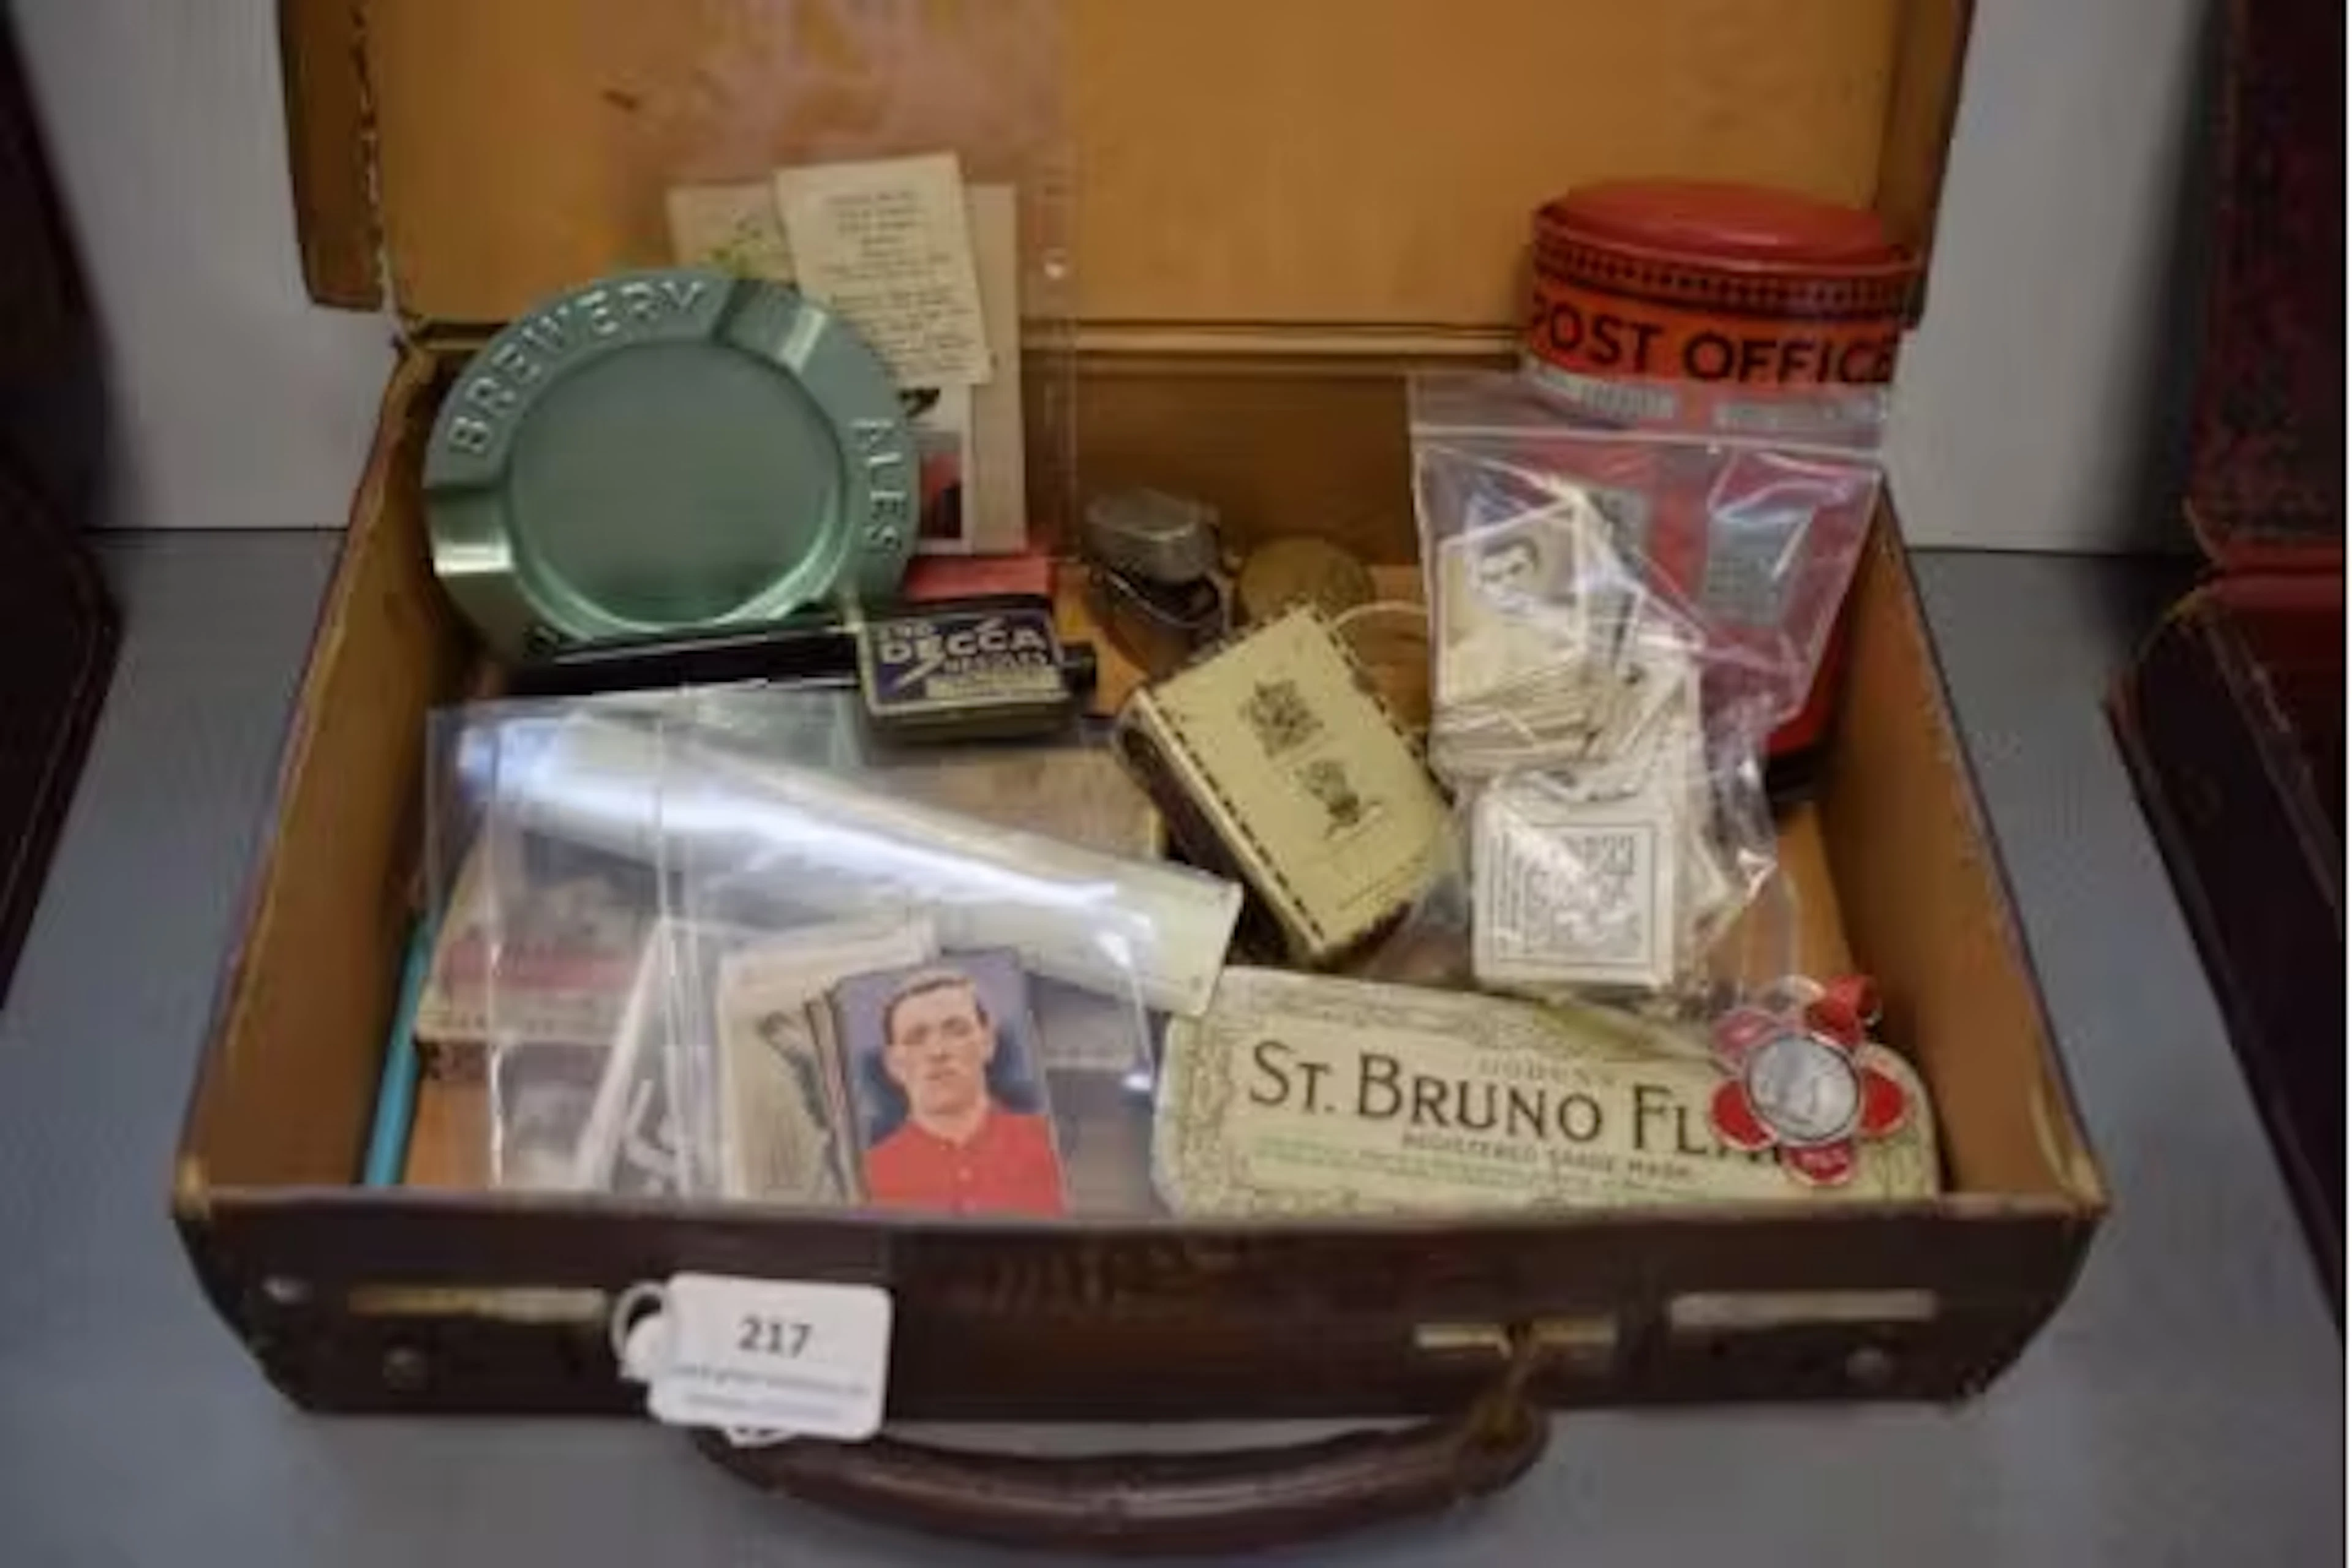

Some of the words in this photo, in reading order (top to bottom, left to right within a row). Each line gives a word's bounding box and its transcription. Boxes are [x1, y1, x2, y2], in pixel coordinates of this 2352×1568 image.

[448, 279, 706, 456] BREWERY
[853, 417, 905, 557] ALES
[880, 625, 1047, 665] DECCA
[1356, 1050, 1602, 1142] BRUNO
[737, 1315, 813, 1359] 217
